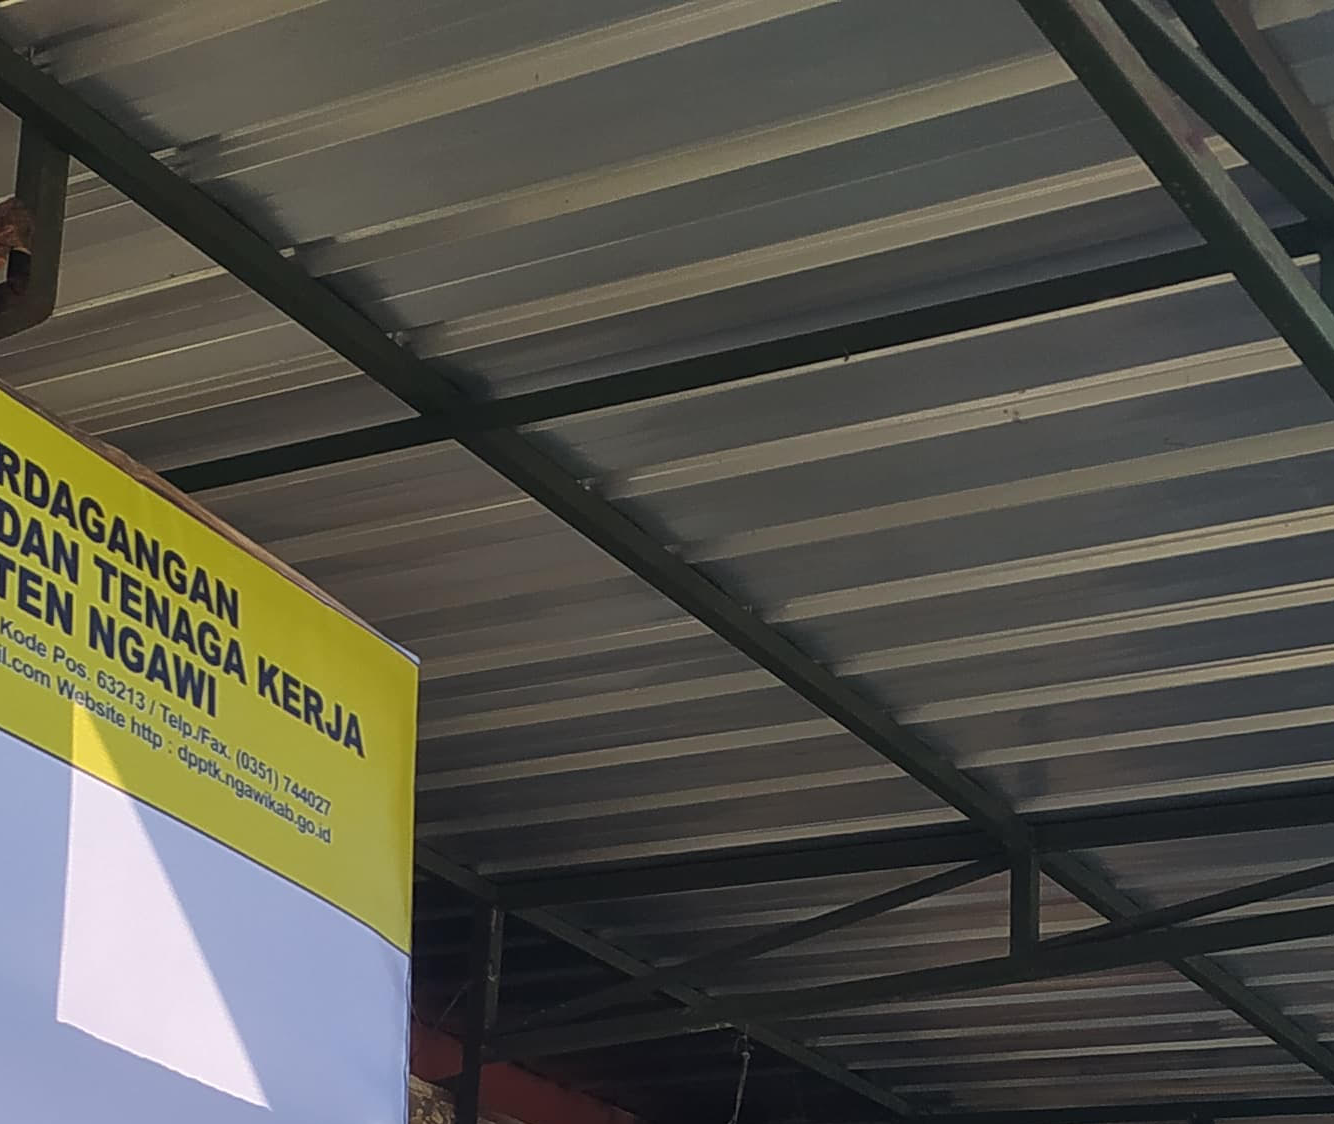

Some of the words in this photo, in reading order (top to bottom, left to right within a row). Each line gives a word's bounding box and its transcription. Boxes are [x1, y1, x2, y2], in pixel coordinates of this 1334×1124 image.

[0, 617, 47, 658] Kode
[53, 645, 91, 681] Pos.
[97, 670, 145, 711] 63213
[160, 703, 231, 760] Telp./Fax.
[236, 749, 279, 791] (0351)
[283, 775, 331, 816] 744027
[89, 605, 216, 718] NGAWI
[92, 553, 247, 685] TENAGA
[257, 655, 366, 758] KERJA
[56, 675, 126, 728] Website
[131, 715, 162, 750] http
[178, 745, 331, 843] dpptk.ngawikab.go.id
